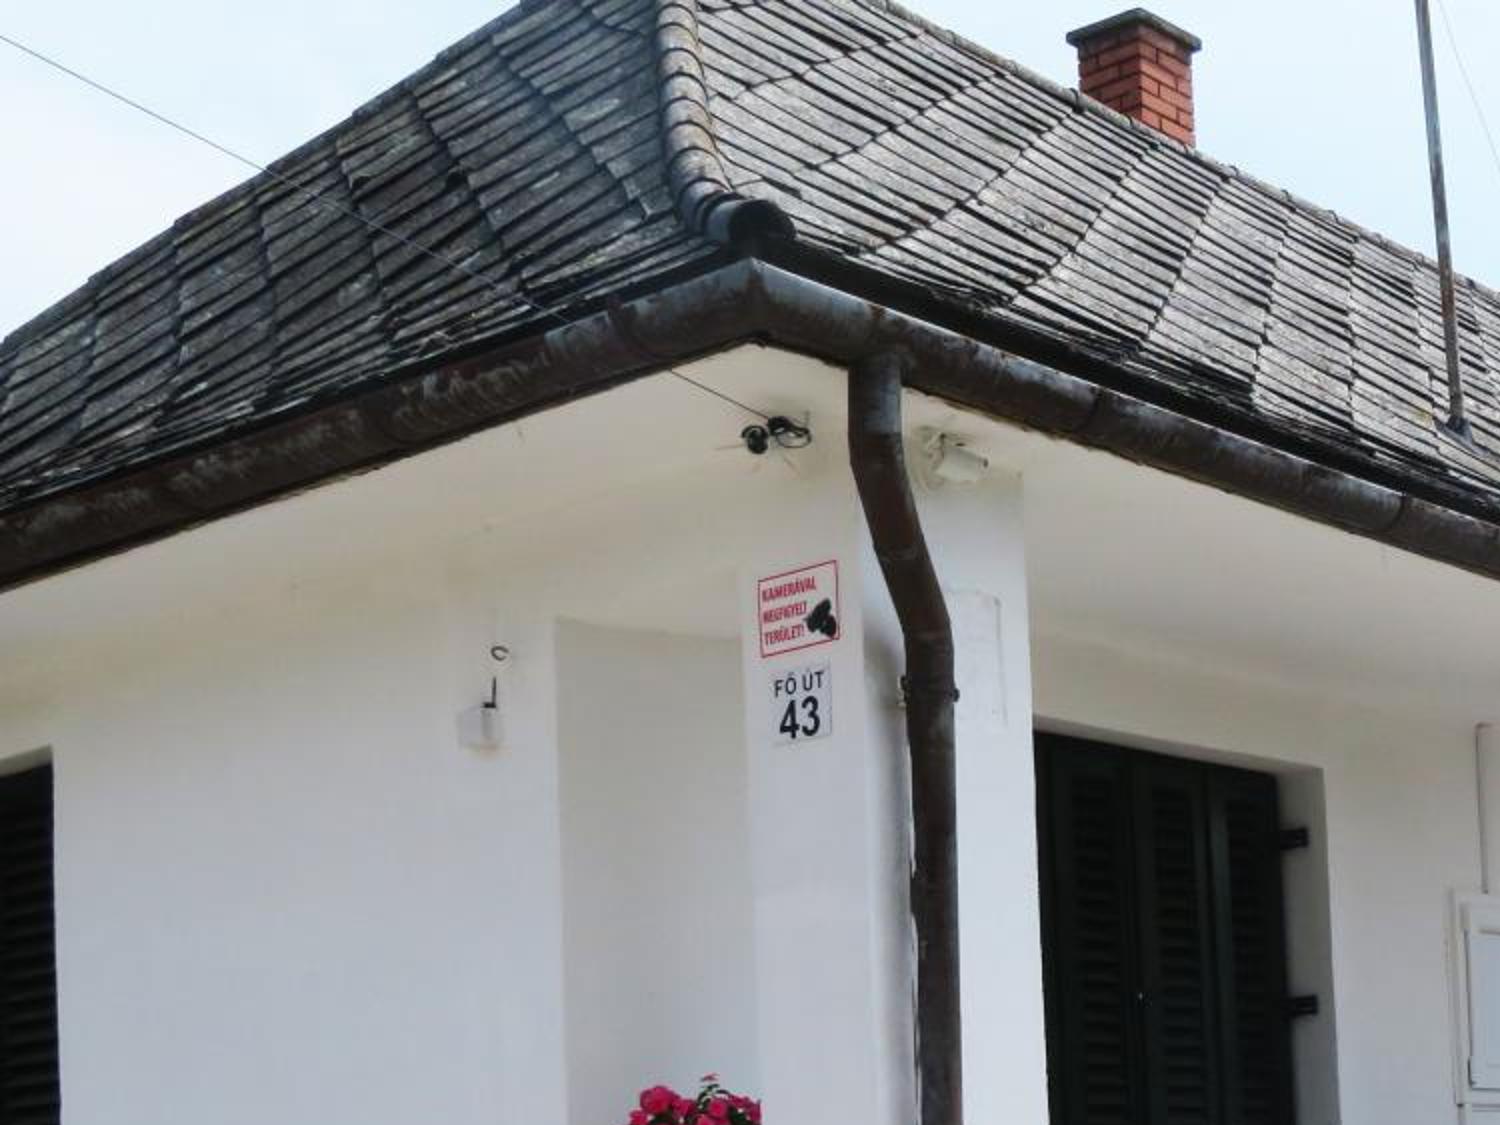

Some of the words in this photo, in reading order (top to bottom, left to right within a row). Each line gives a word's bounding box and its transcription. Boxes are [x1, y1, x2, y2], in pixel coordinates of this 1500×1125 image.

[762, 576, 817, 602] KAMERÁVAL
[763, 601, 807, 623] MEGFIGYELT
[765, 623, 805, 645] TERÜLET!
[802, 667, 825, 691] ÚT
[779, 698, 821, 739] 43
